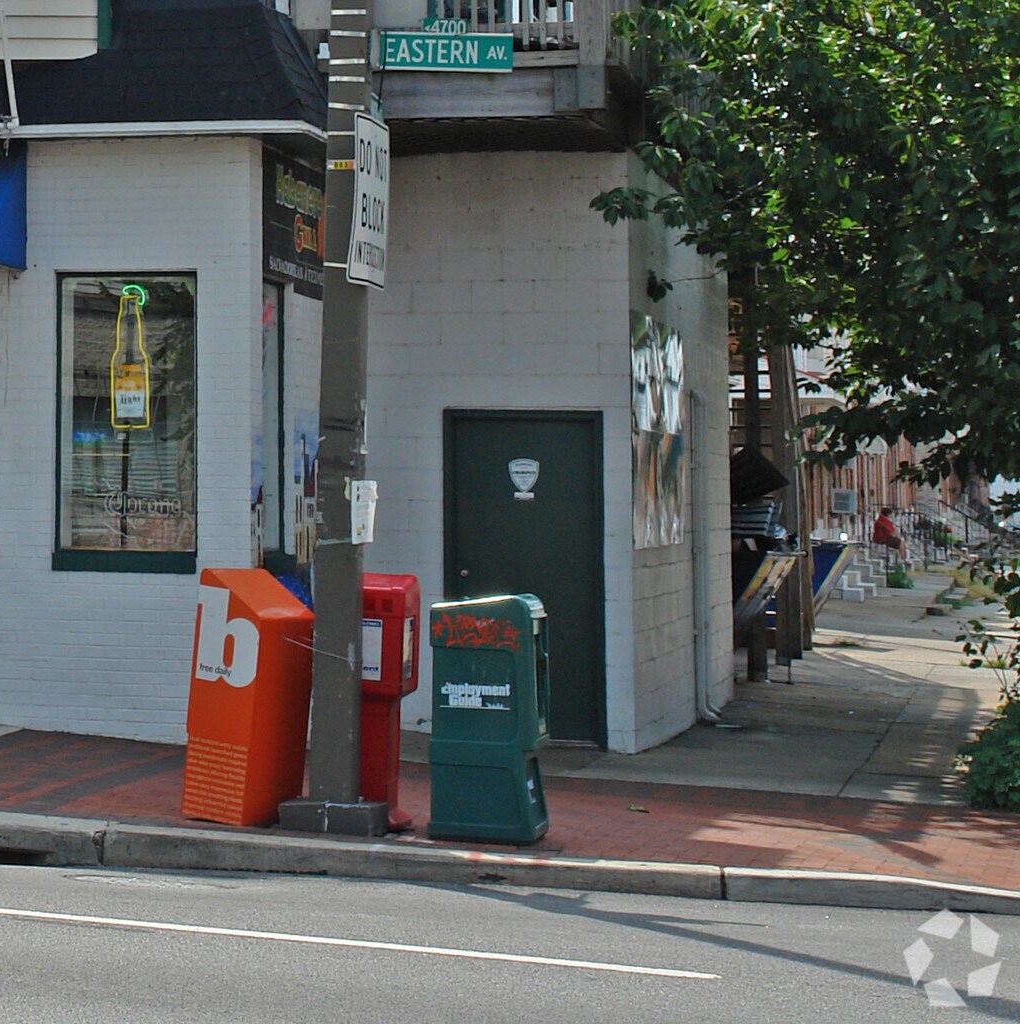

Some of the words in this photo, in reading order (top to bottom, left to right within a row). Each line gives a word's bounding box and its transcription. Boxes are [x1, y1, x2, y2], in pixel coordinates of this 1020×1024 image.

[431, 20, 467, 34] 4700
[385, 38, 478, 64] EASTERN
[486, 45, 508, 61] AV.
[360, 138, 372, 176] DO
[375, 143, 387, 182] NOT
[361, 192, 385, 235] BLOCK
[199, 663, 213, 674] free
[214, 665, 232, 678] daily
